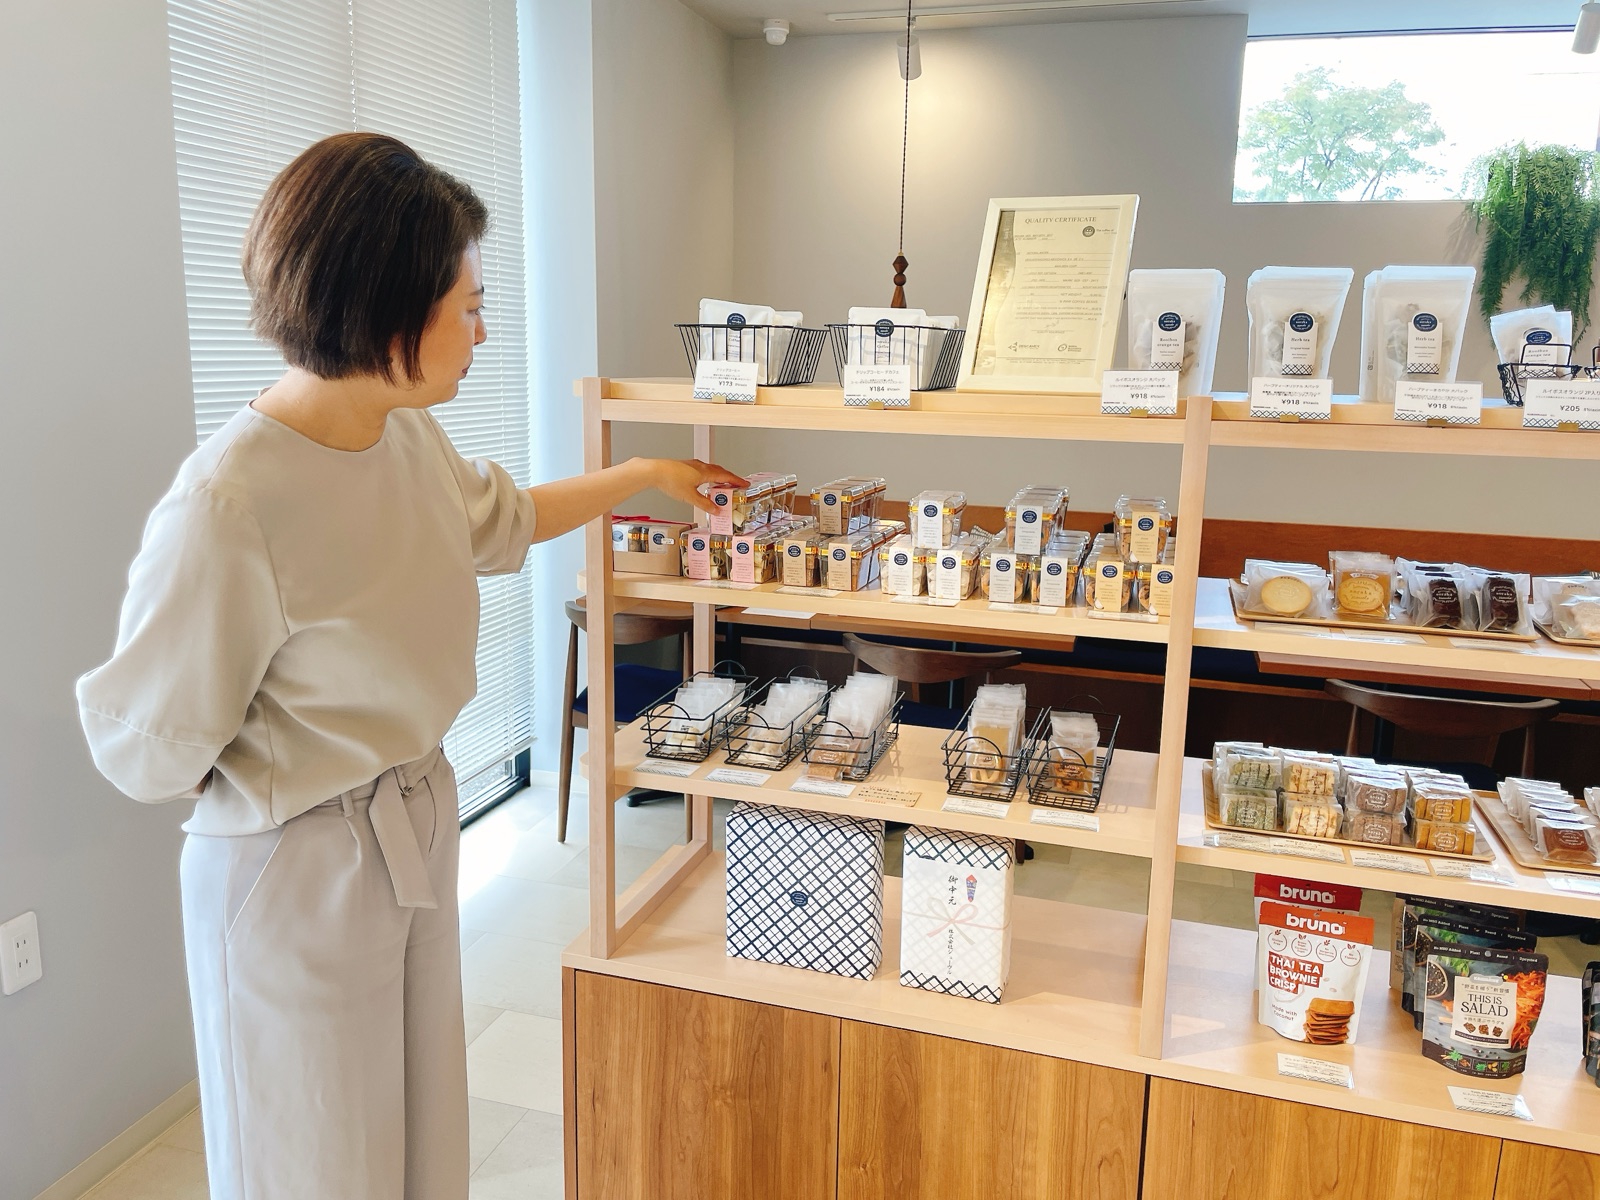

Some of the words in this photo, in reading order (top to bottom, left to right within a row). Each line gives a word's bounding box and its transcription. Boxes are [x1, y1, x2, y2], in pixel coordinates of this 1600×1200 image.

[948, 875, 958, 905] 御中元
[1280, 884, 1334, 904] bruno
[1286, 913, 1342, 935] bruno
[1271, 955, 1295, 969] THAI
[1299, 962, 1320, 974] TEA
[1270, 965, 1318, 985] BROWNIE
[1270, 976, 1296, 991] CRISP
[1272, 1004, 1284, 1012] Made
[1467, 994, 1491, 1003] THIS
[1461, 1001, 1509, 1017] SALAD
